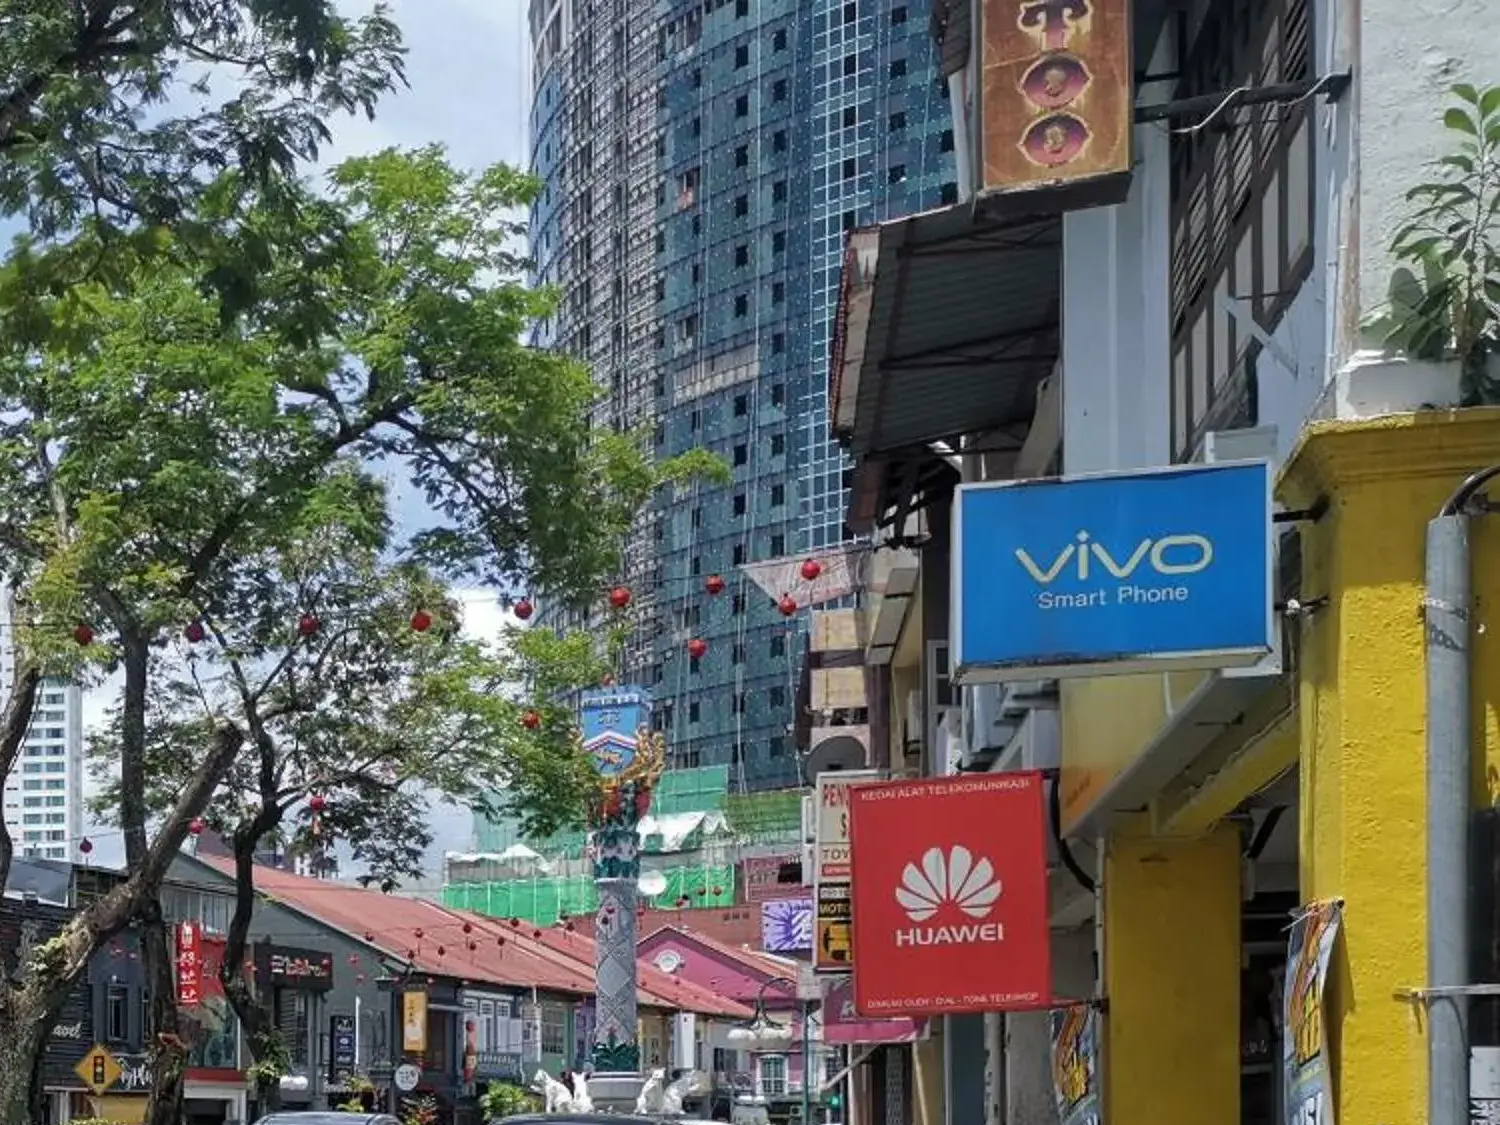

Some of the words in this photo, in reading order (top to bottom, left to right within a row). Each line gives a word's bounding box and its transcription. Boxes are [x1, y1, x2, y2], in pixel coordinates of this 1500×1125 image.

[1038, 587, 1107, 609] Smart
[1117, 585, 1189, 605] Phone
[896, 923, 1004, 946] HUAWEI
